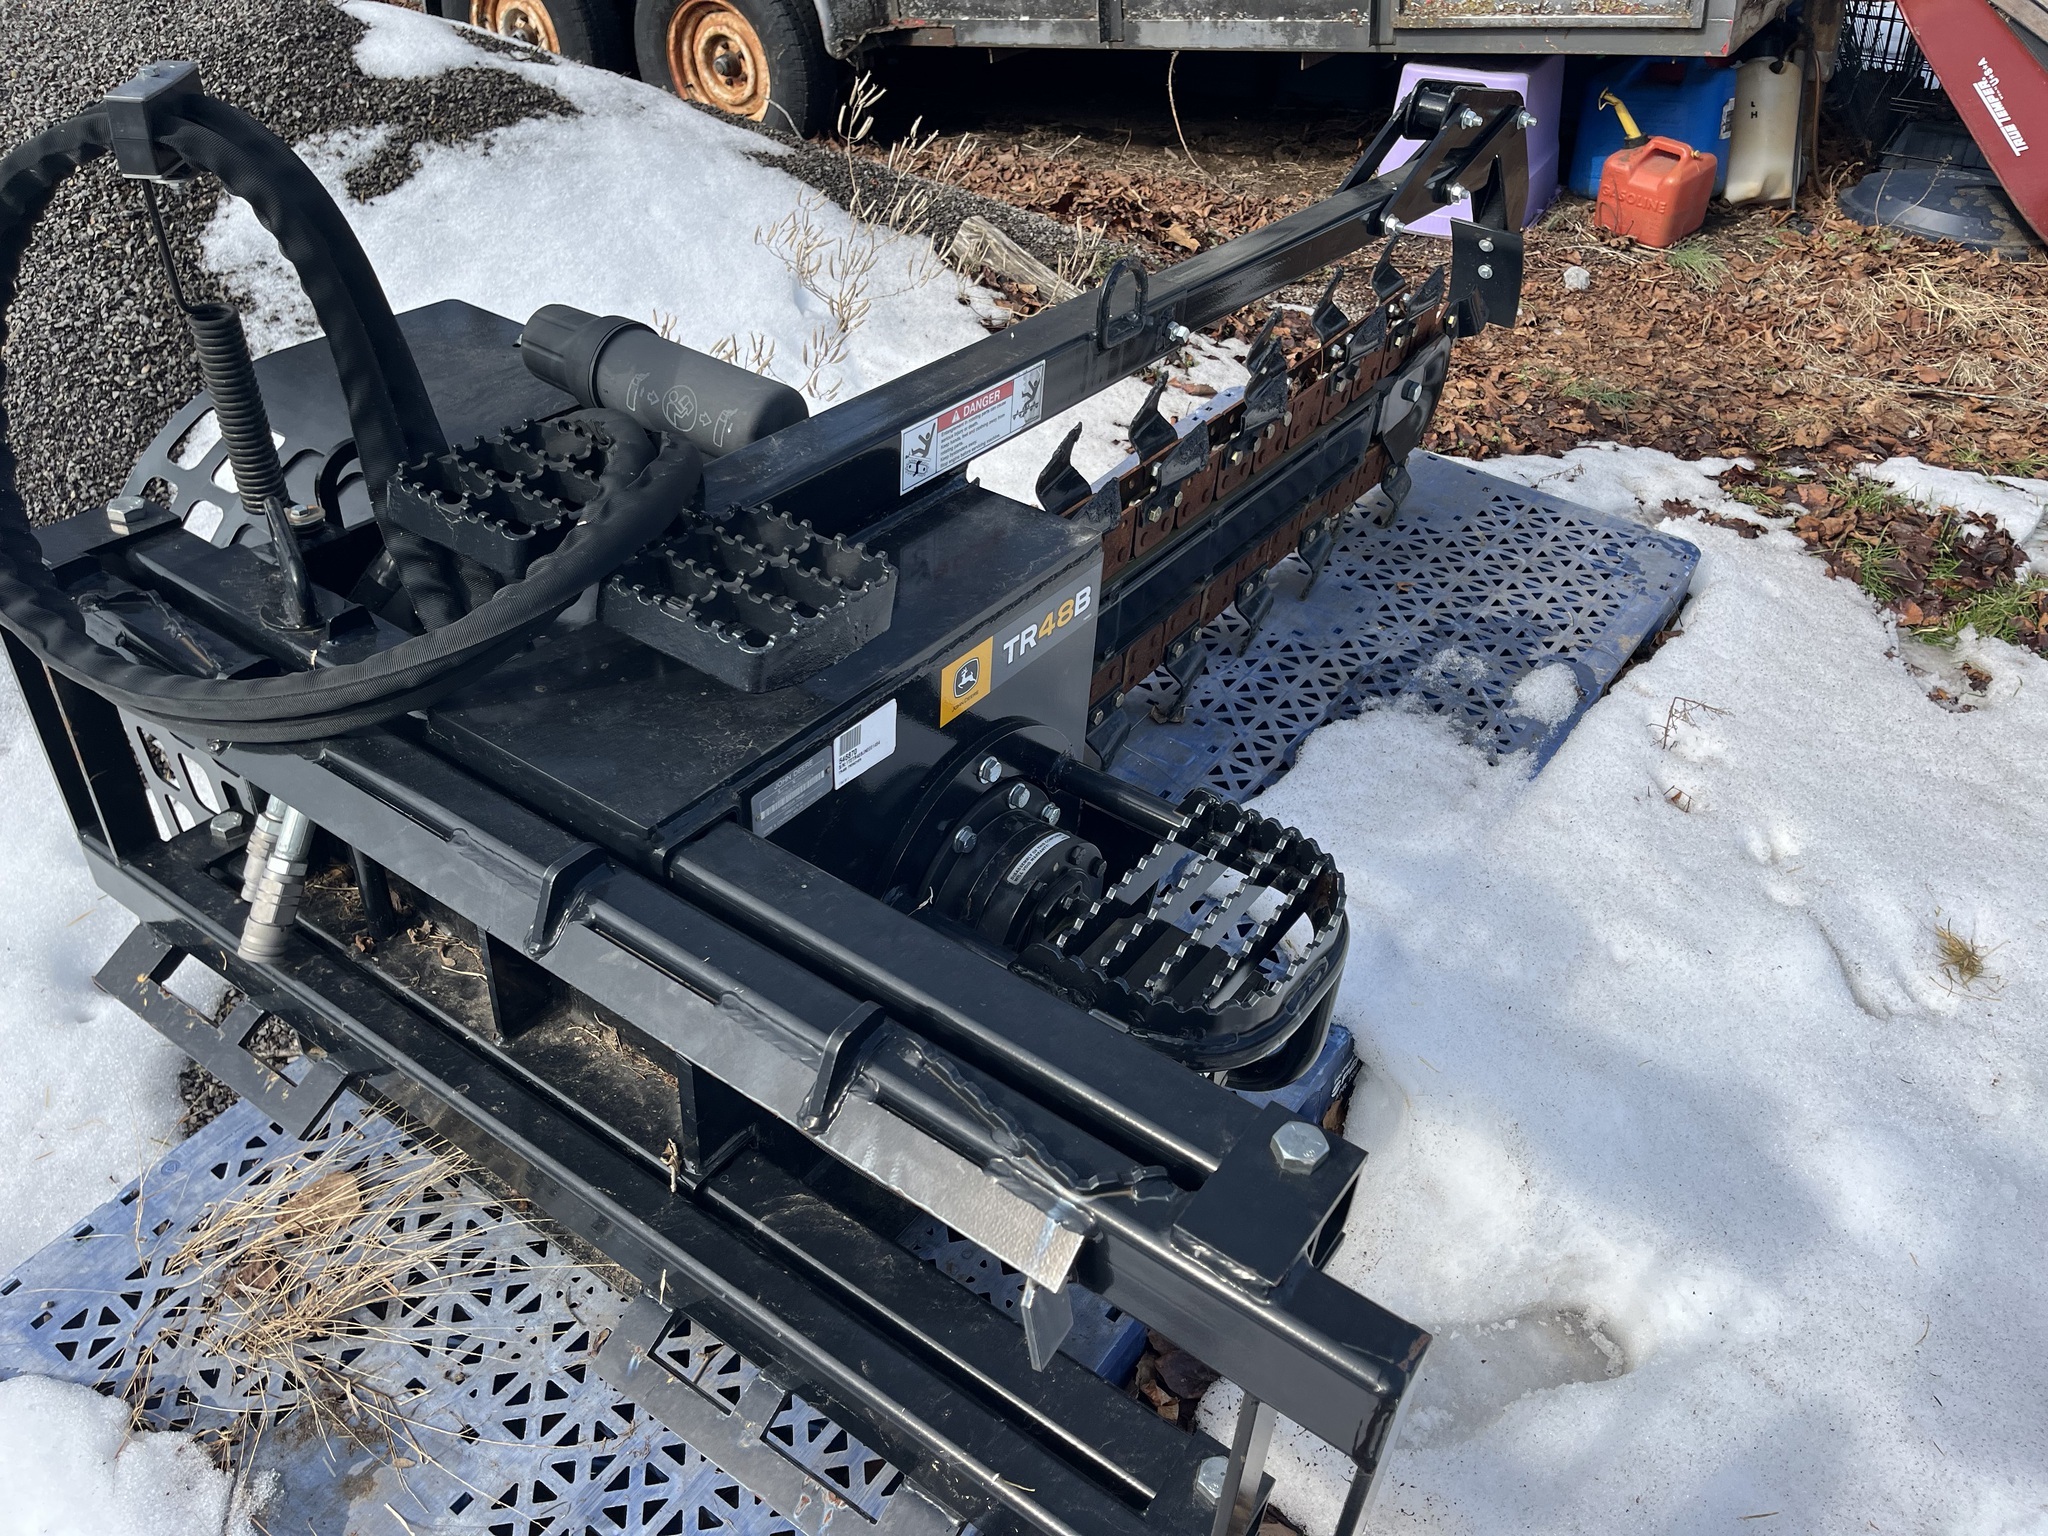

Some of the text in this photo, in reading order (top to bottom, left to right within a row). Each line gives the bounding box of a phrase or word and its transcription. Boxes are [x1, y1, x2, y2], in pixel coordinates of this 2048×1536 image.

[2000, 123, 2029, 157] TRUE
[1602, 184, 1667, 214] GASOLINE
[964, 390, 1000, 417] DANGER
[1003, 585, 1092, 664] TR48B
[952, 690, 979, 712] JOHN DEERE
[774, 774, 792, 790] JOHN
[793, 759, 813, 777] DEERE
[1014, 872, 1023, 881] WILL
[1022, 862, 1031, 870] VOID
